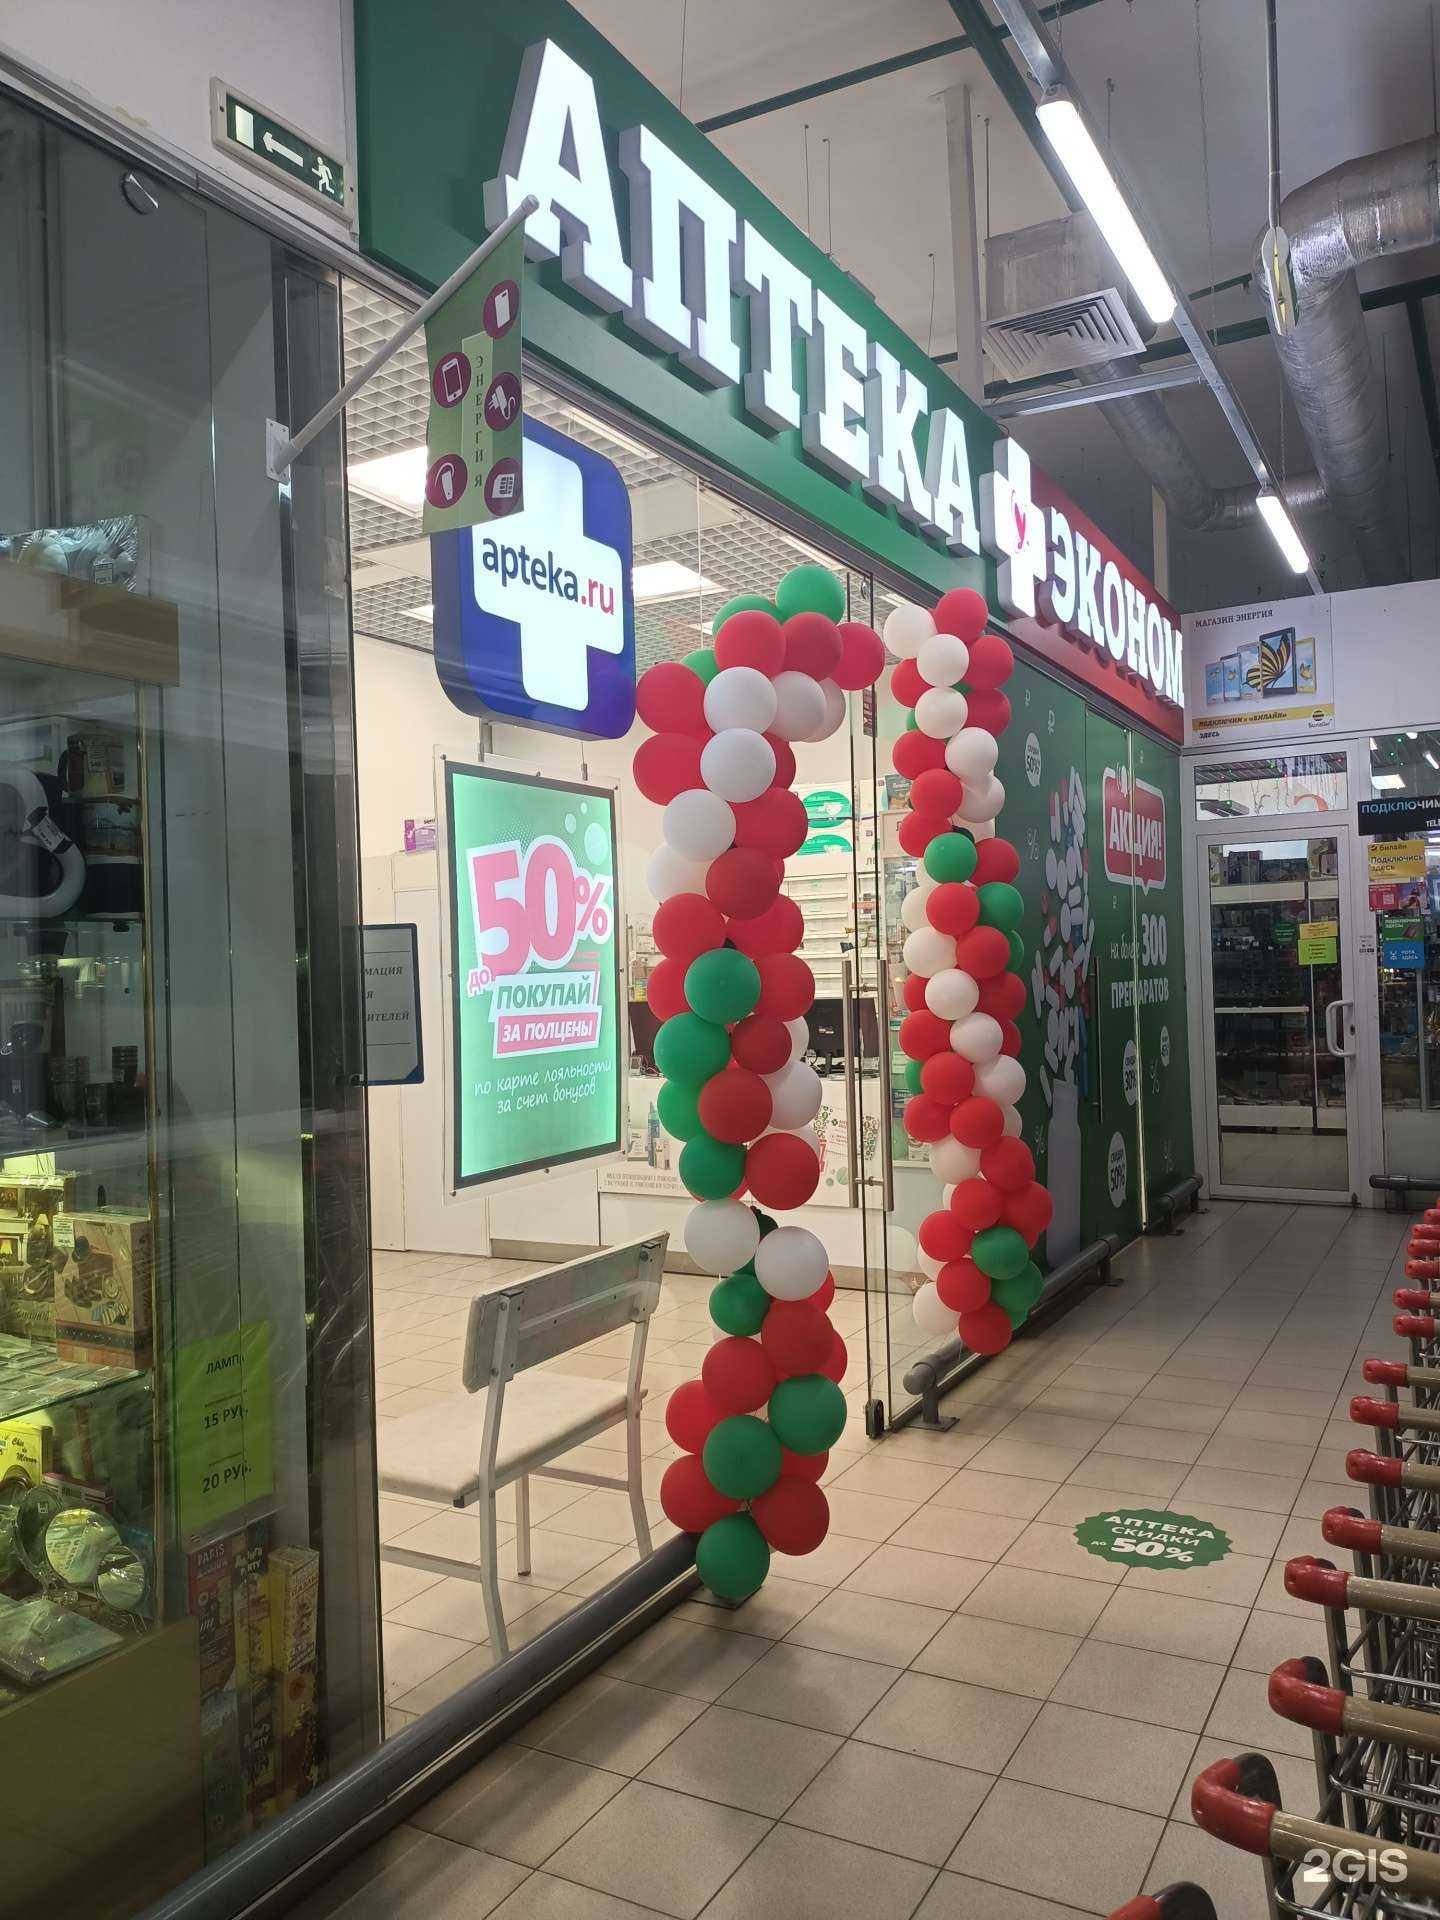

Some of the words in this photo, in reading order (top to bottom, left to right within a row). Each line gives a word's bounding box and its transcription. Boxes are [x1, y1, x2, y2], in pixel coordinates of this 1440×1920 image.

[504, 38, 980, 556] АПТЕКА
[474, 355, 485, 488] ЭНЕРГИЯ
[481, 537, 615, 615] apteka.ru
[1050, 505, 1185, 709] ЭКОНОМ
[1195, 615, 1234, 628] МАГАЗИН
[1236, 609, 1273, 622] ЭНЕРГИЯ
[1199, 717, 1243, 728] ПОДКЛЮЧИМ
[1199, 731, 1220, 740] ЗДЕСЬ
[1361, 799, 1440, 814] ПОДКЛЮЧИМ
[1109, 806, 1162, 866] АКЦИЯ!
[1379, 843, 1407, 851] билайн
[1370, 855, 1424, 864] Подключись
[472, 843, 608, 976] 50%
[1141, 912, 1168, 967] 300
[1111, 977, 1170, 1009] ПРЕПАРАТОВ
[501, 1024, 521, 1043] ЗА
[524, 1020, 593, 1042] ПОЛЦЕНЫ
[473, 1080, 492, 1097] по
[496, 1071, 540, 1096] карте
[543, 1060, 613, 1084] лояльности
[496, 1099, 512, 1114] за
[516, 1091, 549, 1110] счет
[552, 1076, 598, 1103] бонусов
[203, 1411, 220, 1430] 15
[202, 1472, 220, 1494] 20
[1103, 1515, 1216, 1540] АПТЕКА
[1110, 1526, 1200, 1547] СКИДКИ
[1111, 1537, 1196, 1563] 50%
